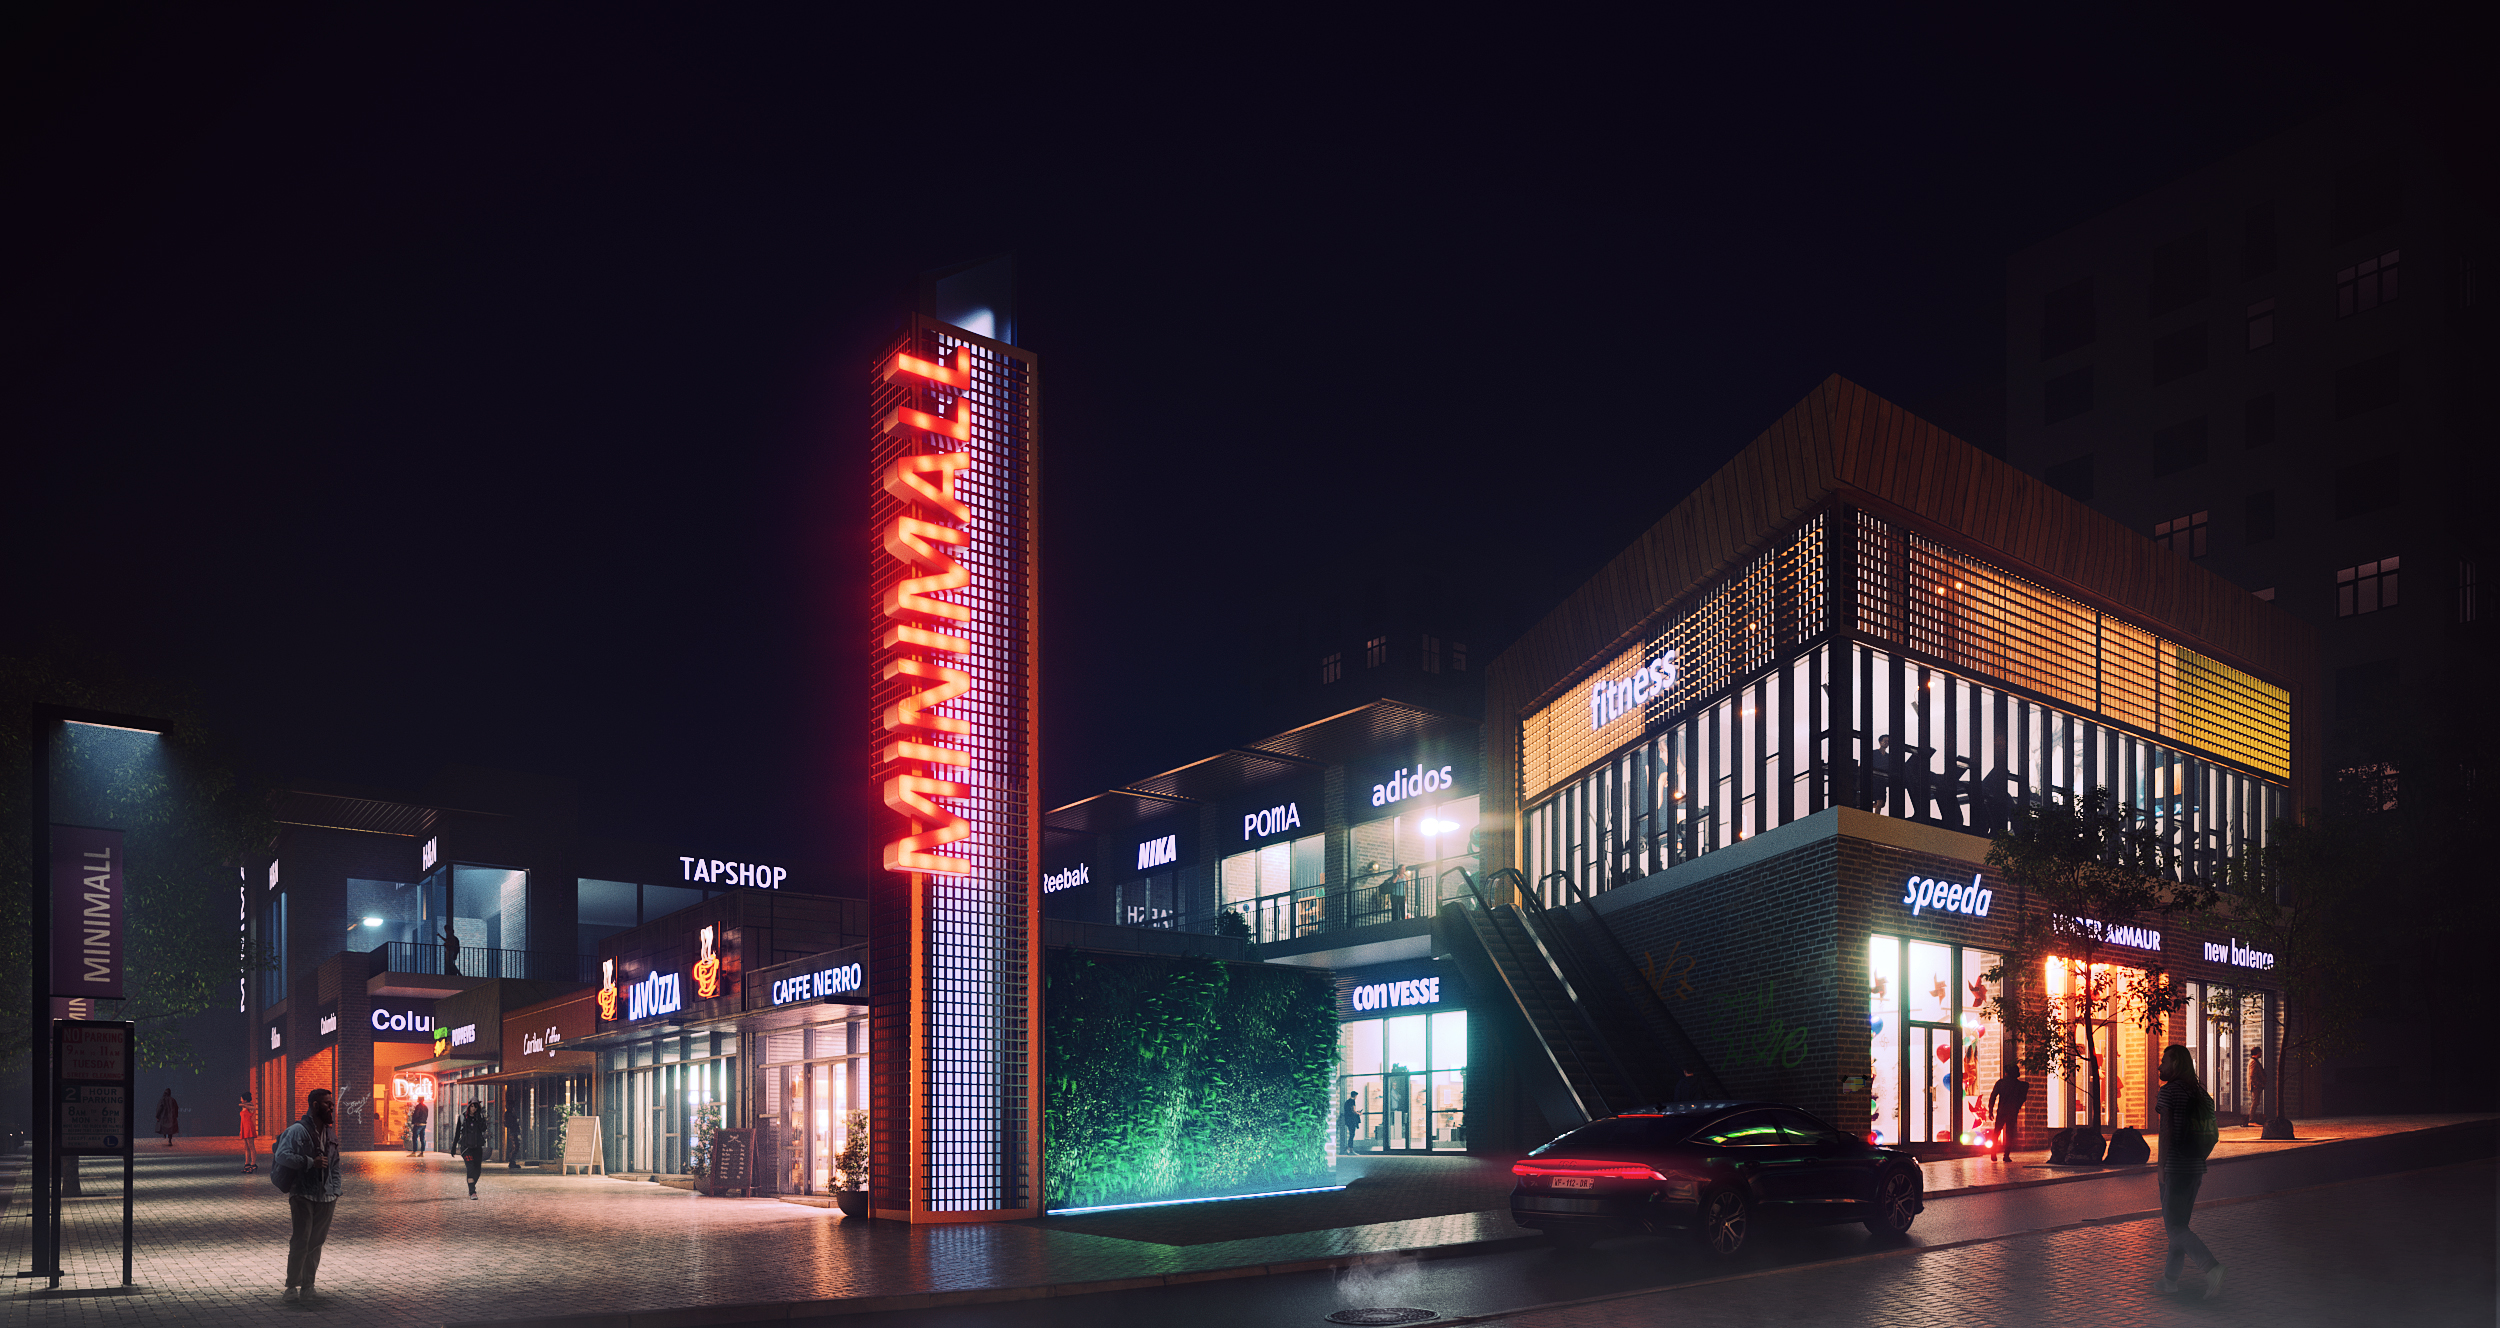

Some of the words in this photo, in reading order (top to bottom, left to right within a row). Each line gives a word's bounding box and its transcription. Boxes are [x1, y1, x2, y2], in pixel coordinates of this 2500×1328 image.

[886, 345, 971, 876] MINIMALL
[1591, 650, 1676, 731] fitness
[1372, 764, 1453, 807] adidos
[1138, 834, 1177, 870] NIKA
[680, 857, 787, 889] TAPSHOP
[1903, 873, 1993, 917] speeda
[83, 847, 111, 983] MINIMALL
[2104, 922, 2162, 952] ARMAUR
[2204, 941, 2229, 964] new
[628, 970, 681, 1021] LAVOZZA
[773, 979, 811, 1006] CAFFE
[813, 962, 862, 998] NERRO
[64, 1028, 79, 1041] NO
[84, 1031, 123, 1043] PARKING
[371, 1008, 435, 1032] Colu
[73, 1059, 115, 1069] TUESDAY
[65, 1087, 77, 1101] 2
[89, 1088, 117, 1096] HOUR
[82, 1096, 123, 1104] PARKING
[394, 1077, 433, 1098] Draft
